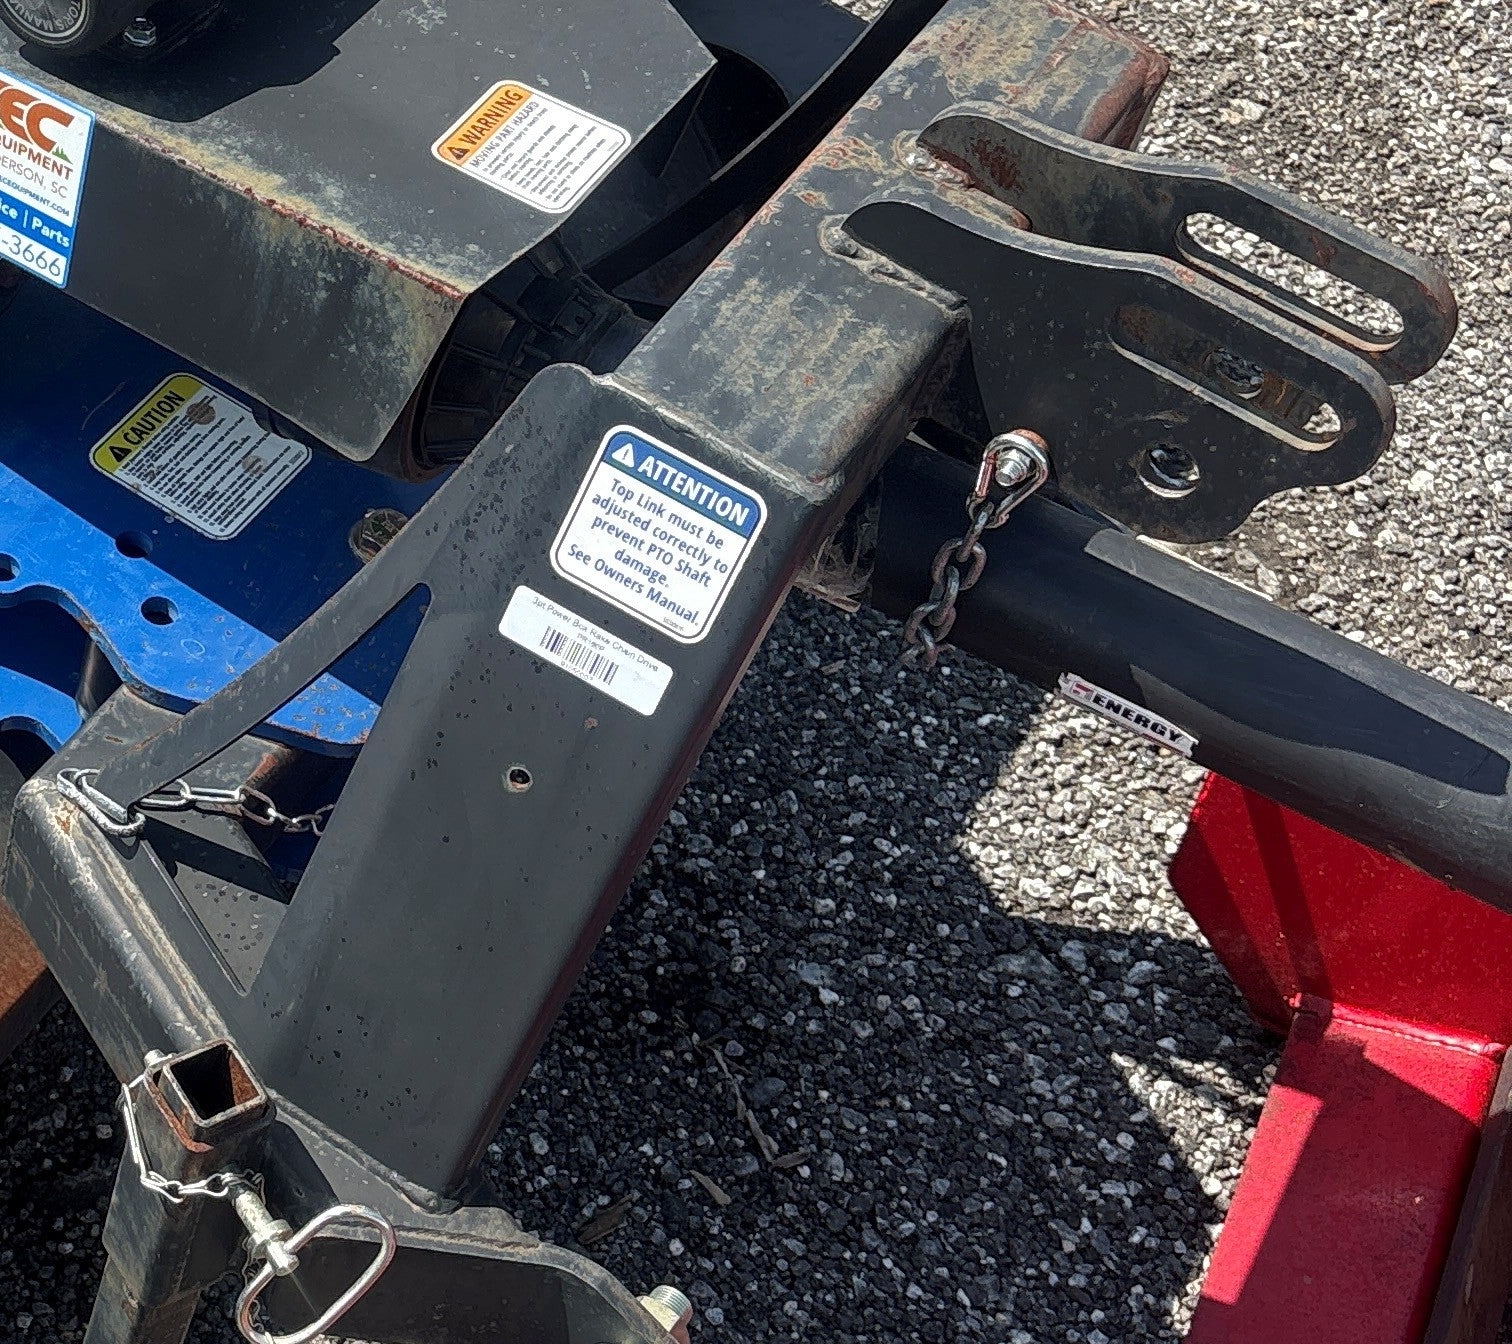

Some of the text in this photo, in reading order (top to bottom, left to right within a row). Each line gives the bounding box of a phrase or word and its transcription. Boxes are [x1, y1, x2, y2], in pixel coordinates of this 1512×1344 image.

[458, 89, 524, 146] WARNING
[51, 178, 68, 199] SC
[31, 218, 71, 248] Parts
[123, 390, 186, 445] CAUTION
[610, 478, 724, 550] Top Link must be
[638, 455, 750, 527] ATTENTION
[591, 516, 712, 588] prevent PTO Shaft
[592, 494, 729, 575] adjusted correctly to
[567, 543, 592, 565] See
[594, 559, 643, 595] Owners
[646, 586, 700, 627] Manual.
[614, 548, 671, 588] damage.
[636, 655, 658, 672] Drive
[1092, 693, 1183, 743] ENERGY
